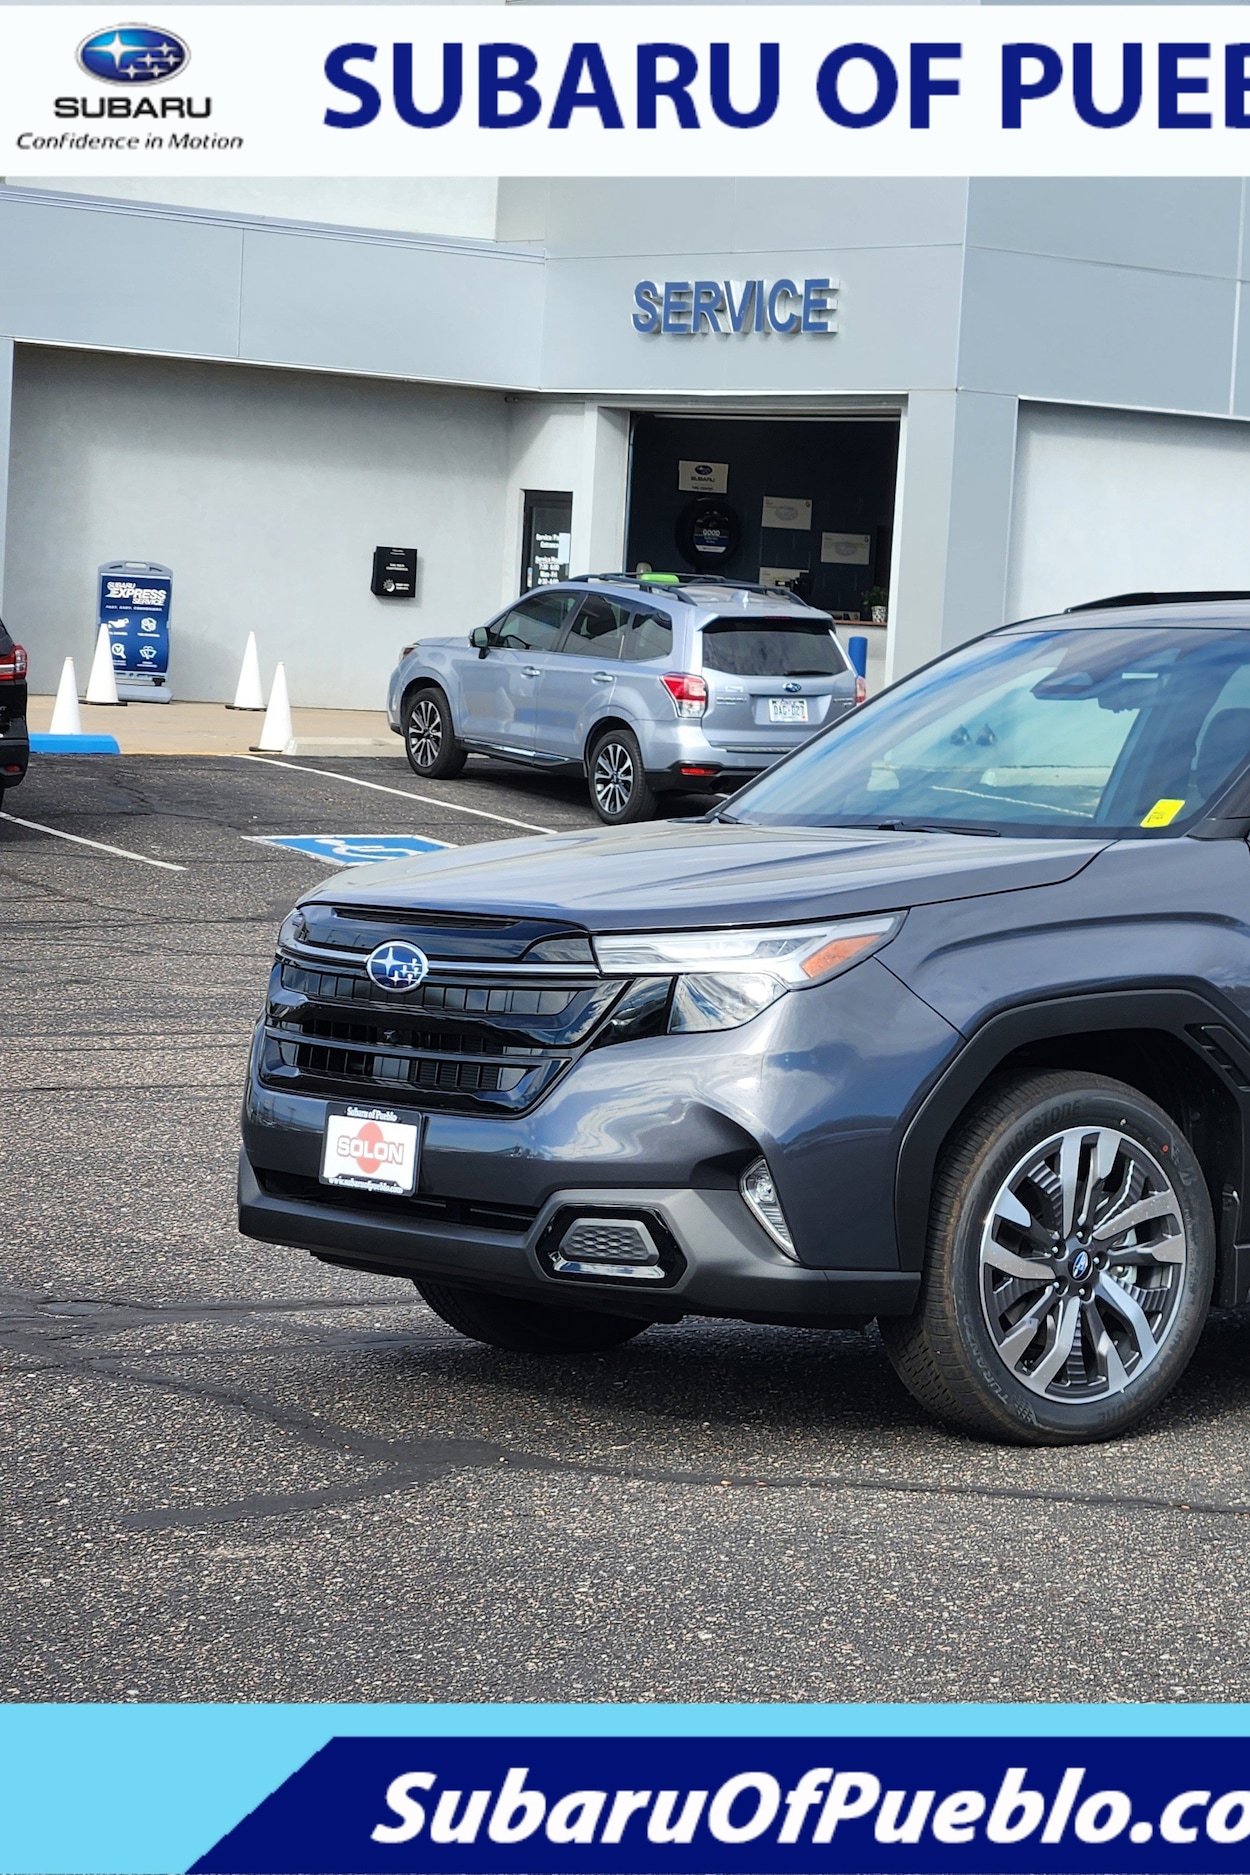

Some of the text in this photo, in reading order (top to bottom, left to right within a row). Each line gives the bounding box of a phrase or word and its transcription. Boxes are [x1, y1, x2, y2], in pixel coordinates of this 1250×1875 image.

[631, 278, 838, 334] SERVICE
[111, 588, 167, 600] EXPRESS
[132, 598, 164, 606] SERVICE
[346, 1106, 368, 1119] Subaru
[375, 1110, 398, 1122] Pueblo
[336, 1134, 405, 1166] SOLON
